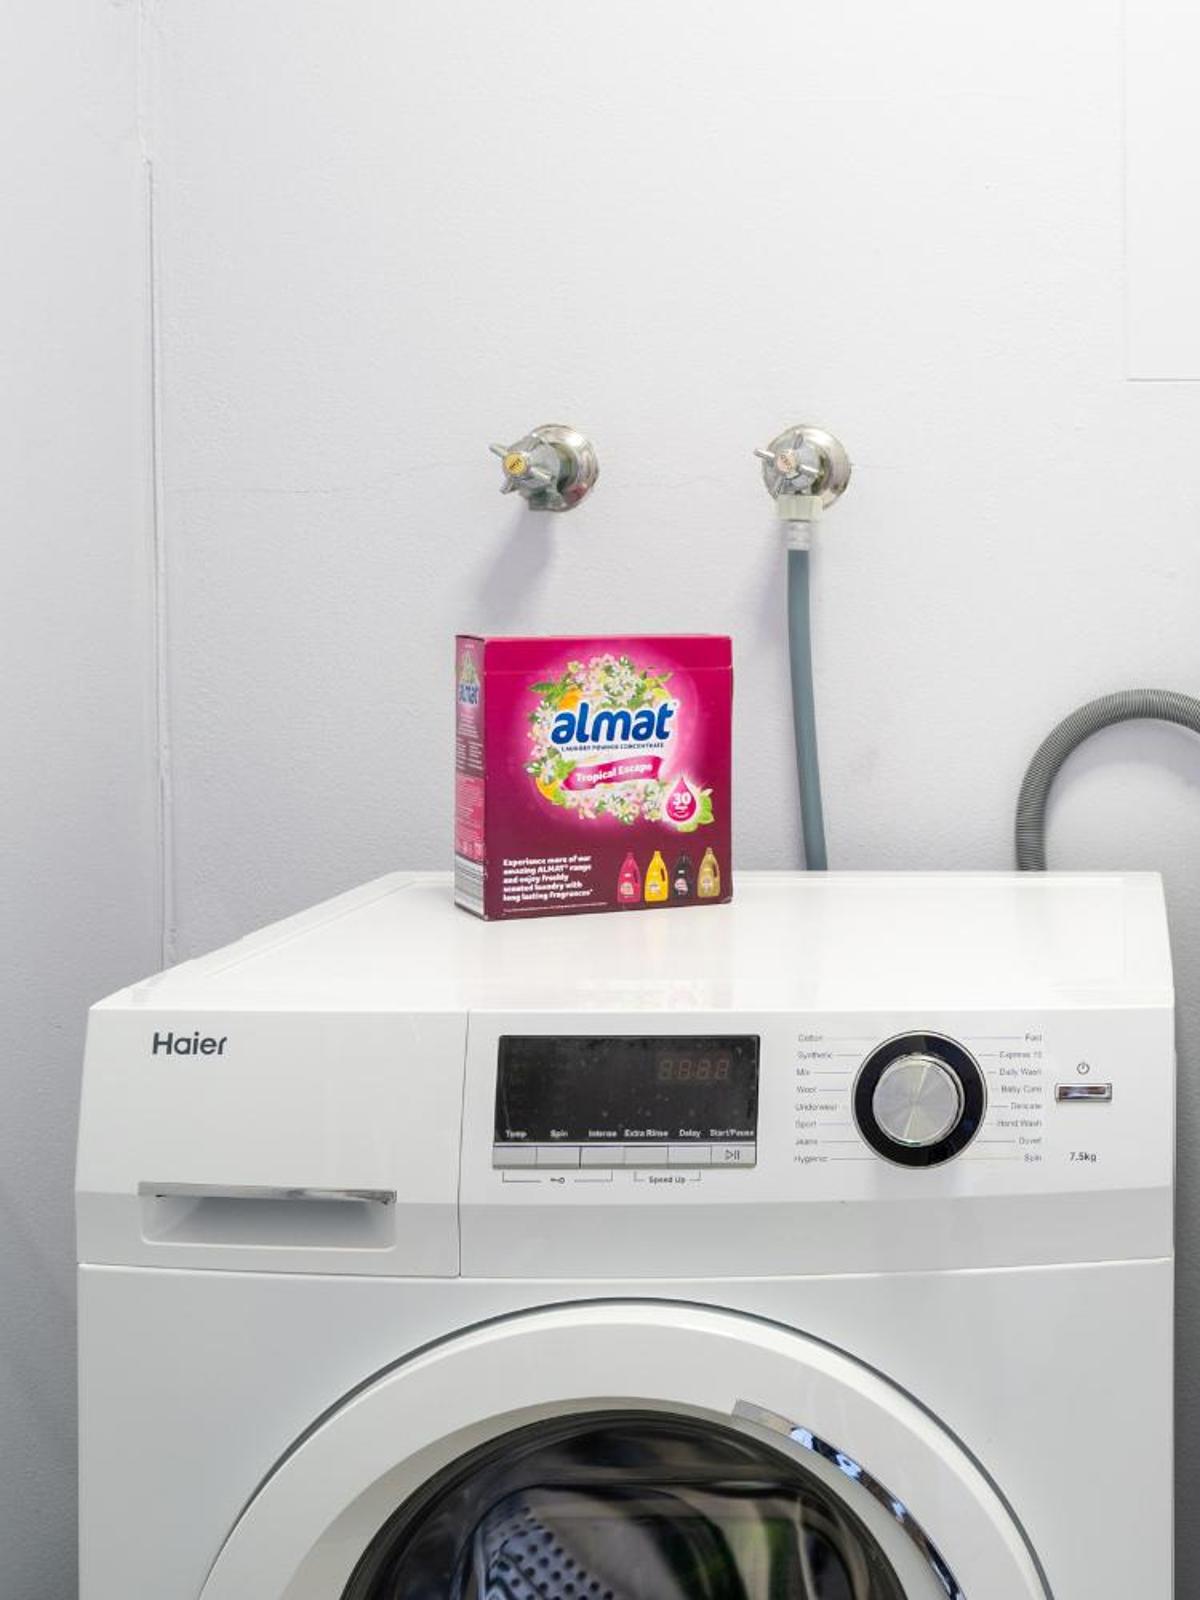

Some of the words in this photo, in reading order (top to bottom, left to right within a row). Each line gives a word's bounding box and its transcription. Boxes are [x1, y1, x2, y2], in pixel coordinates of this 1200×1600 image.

[551, 702, 675, 745] almat
[576, 766, 616, 783] Tropical
[617, 763, 653, 775] Escape
[672, 792, 691, 806] 30
[503, 857, 546, 868] Experience
[547, 855, 567, 864] more
[568, 854, 578, 863] of
[503, 867, 536, 876] amazing
[569, 864, 591, 873] range
[503, 875, 518, 884] and
[519, 874, 540, 884] enjoy
[542, 872, 569, 882] freshly
[503, 884, 533, 893] scented
[534, 882, 564, 891] laundry
[565, 879, 582, 888] with
[503, 893, 520, 903] long
[521, 892, 548, 902] lasting
[152, 1031, 227, 1055] Haier
[549, 1128, 569, 1139] Spin
[588, 1128, 618, 1138] Intense
[624, 1128, 645, 1138] Extra
[646, 1128, 669, 1138] Rinse
[678, 1128, 701, 1139] Delay
[1069, 1151, 1098, 1163] 7.5kg
[649, 1175, 673, 1186] Speed
[674, 1175, 687, 1185] Up
